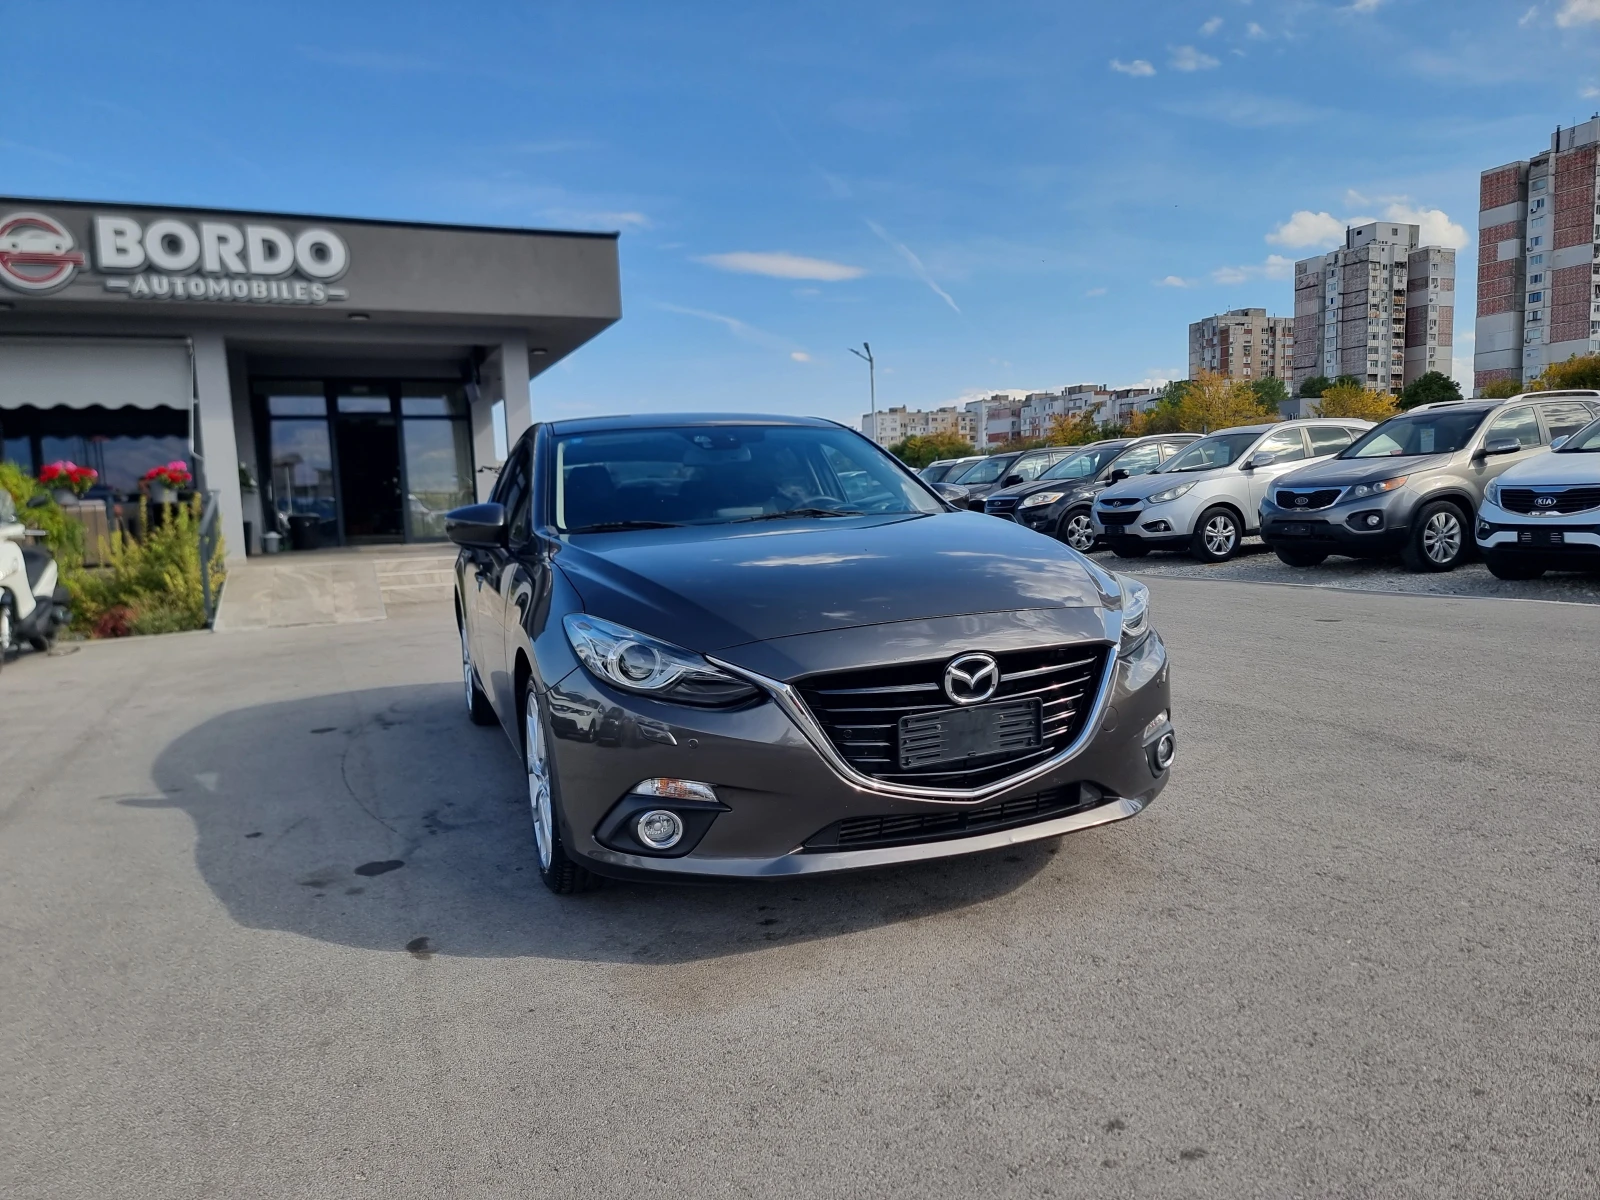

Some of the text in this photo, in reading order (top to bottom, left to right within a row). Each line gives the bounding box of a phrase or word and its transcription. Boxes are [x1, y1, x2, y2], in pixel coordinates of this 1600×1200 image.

[97, 215, 347, 279] BORDO
[130, 274, 326, 302] AUTOMOBILES
[1537, 498, 1553, 506] KIA
